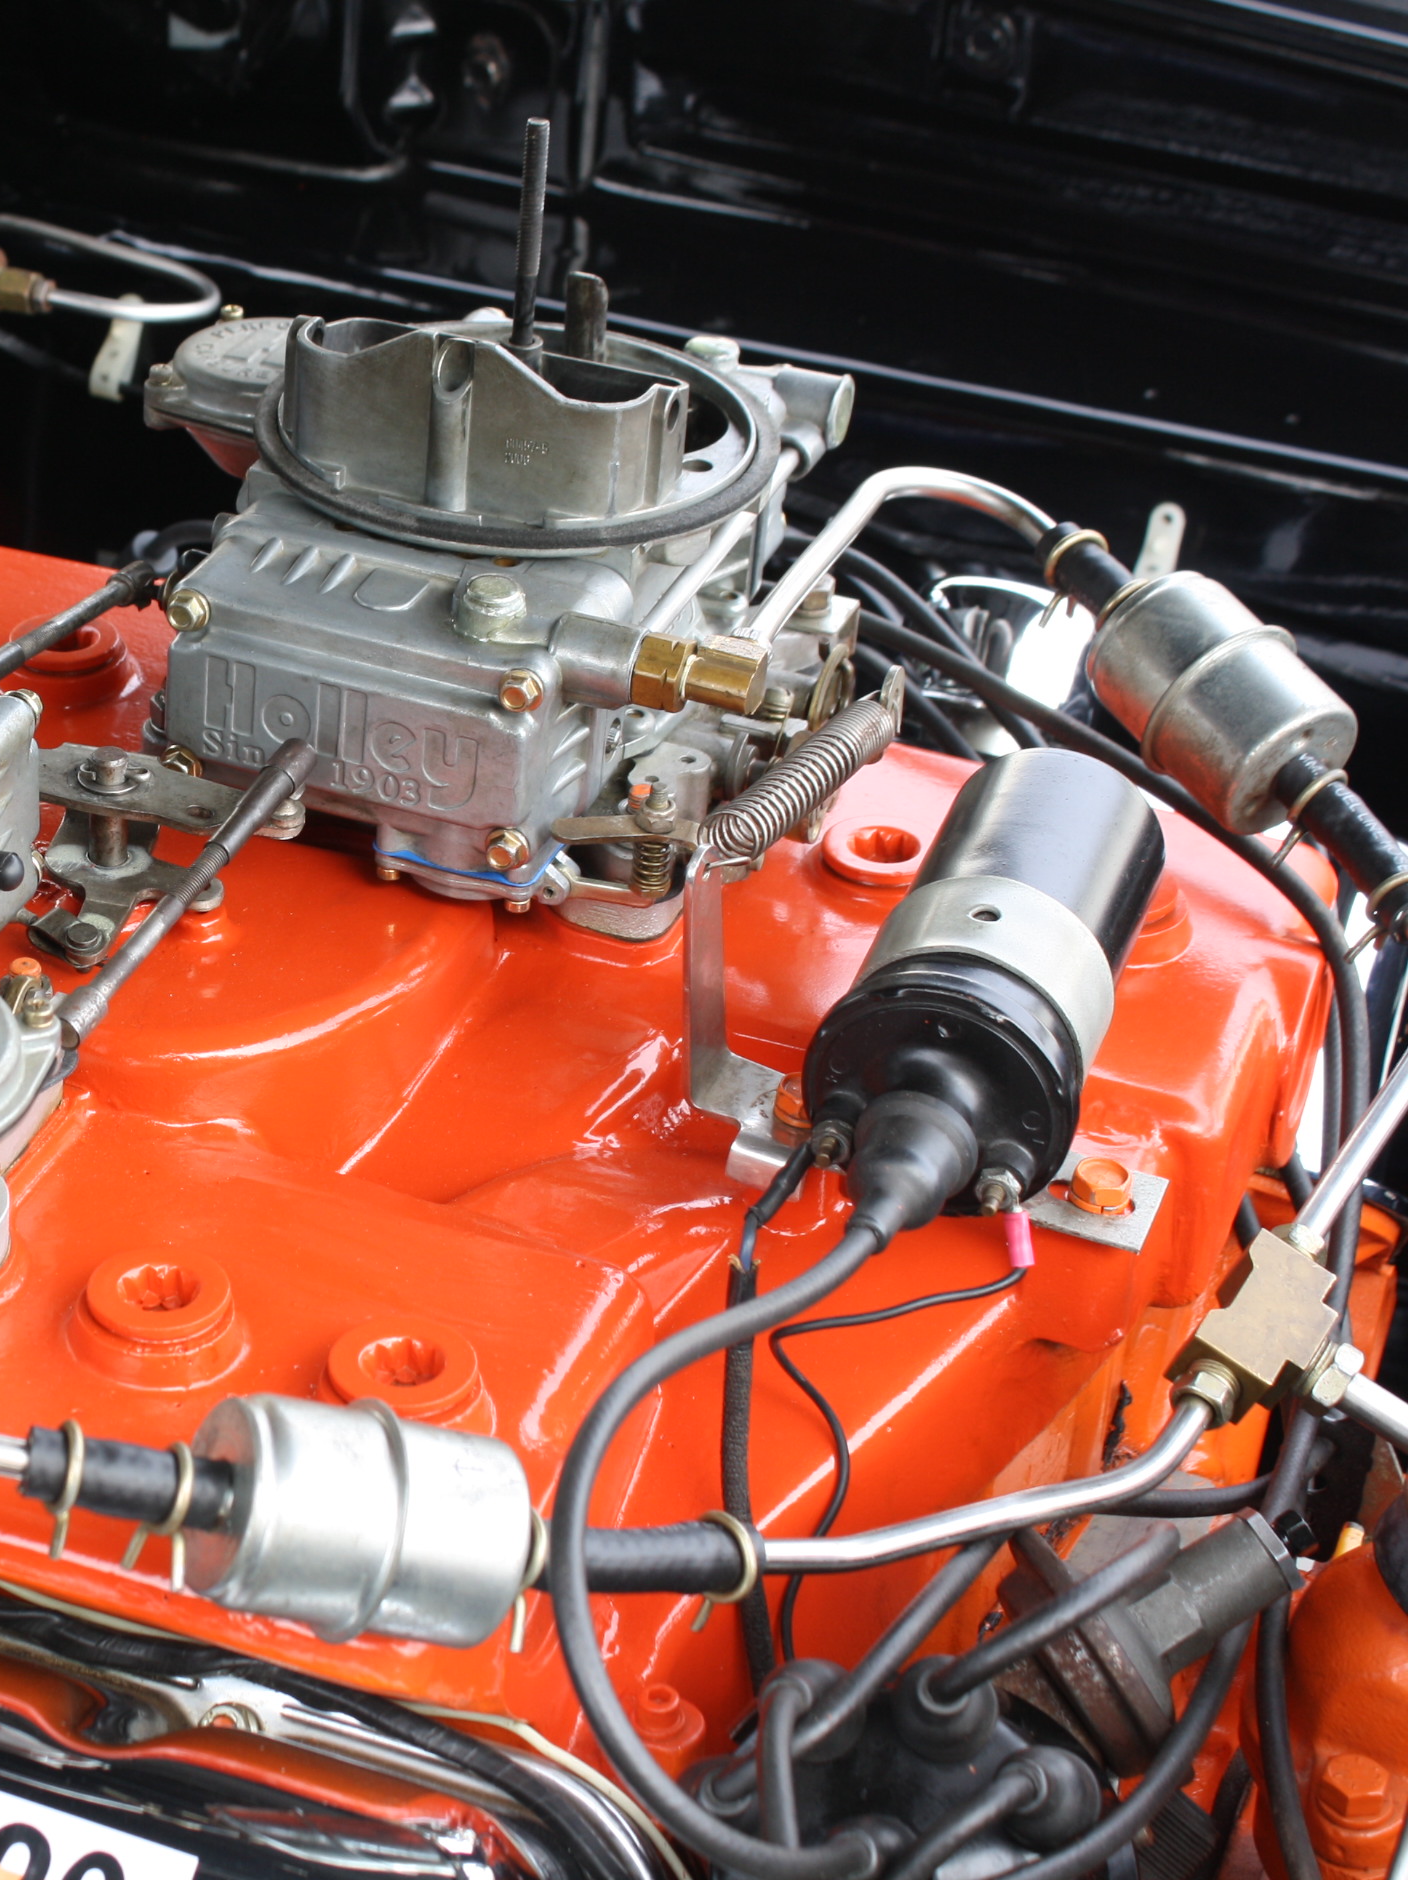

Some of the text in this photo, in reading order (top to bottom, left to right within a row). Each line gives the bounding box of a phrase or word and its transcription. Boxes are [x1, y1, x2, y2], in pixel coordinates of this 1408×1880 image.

[203, 655, 480, 812] Holley
[203, 728, 421, 807] Sin 1903
